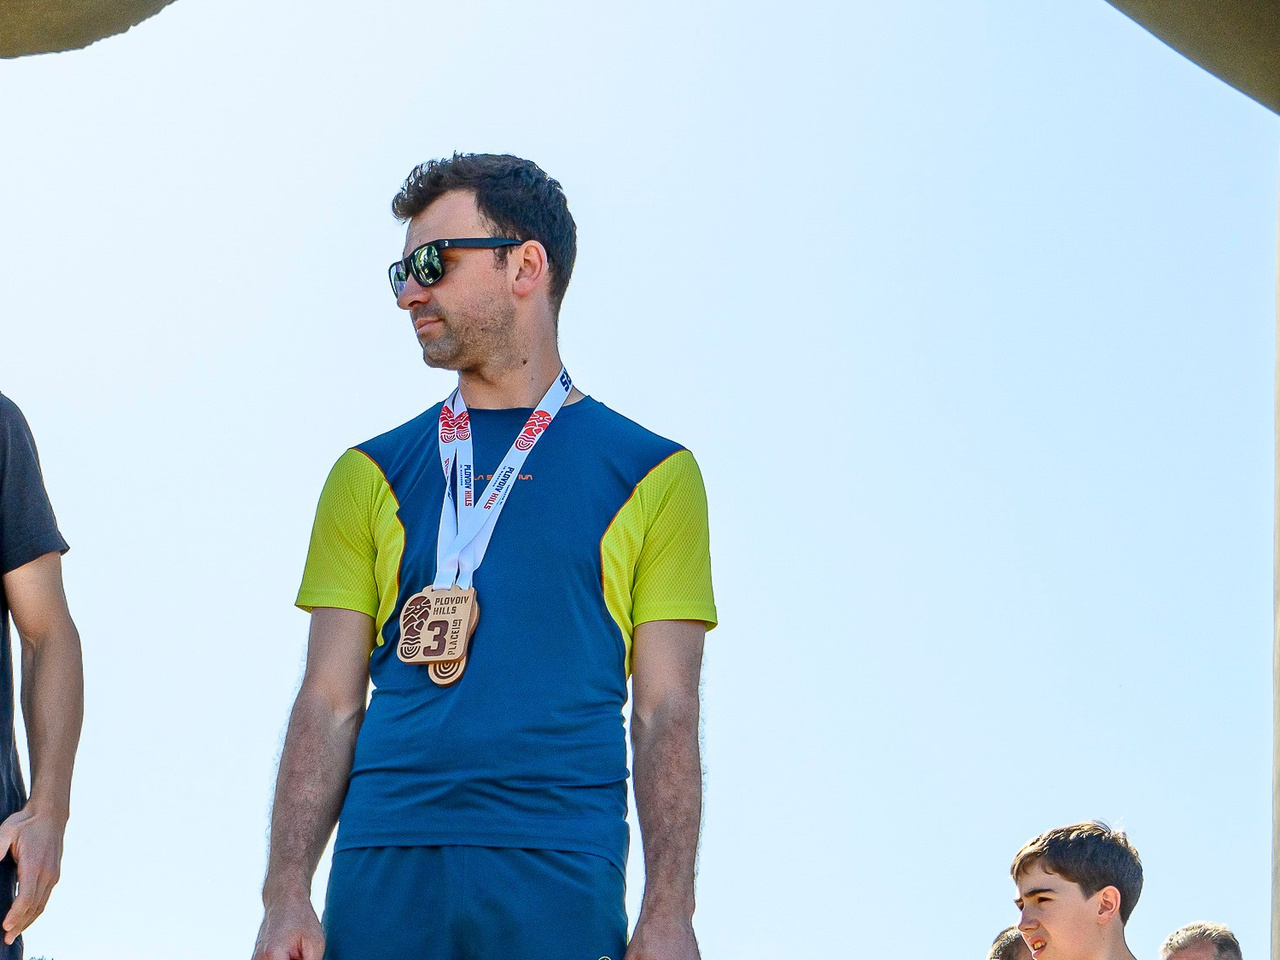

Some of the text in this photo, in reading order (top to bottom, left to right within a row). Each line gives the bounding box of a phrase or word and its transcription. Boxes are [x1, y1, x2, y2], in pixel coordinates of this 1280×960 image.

[434, 596, 470, 605] PLOVDIV
[433, 606, 457, 615] HILLS
[422, 620, 449, 657] 3
